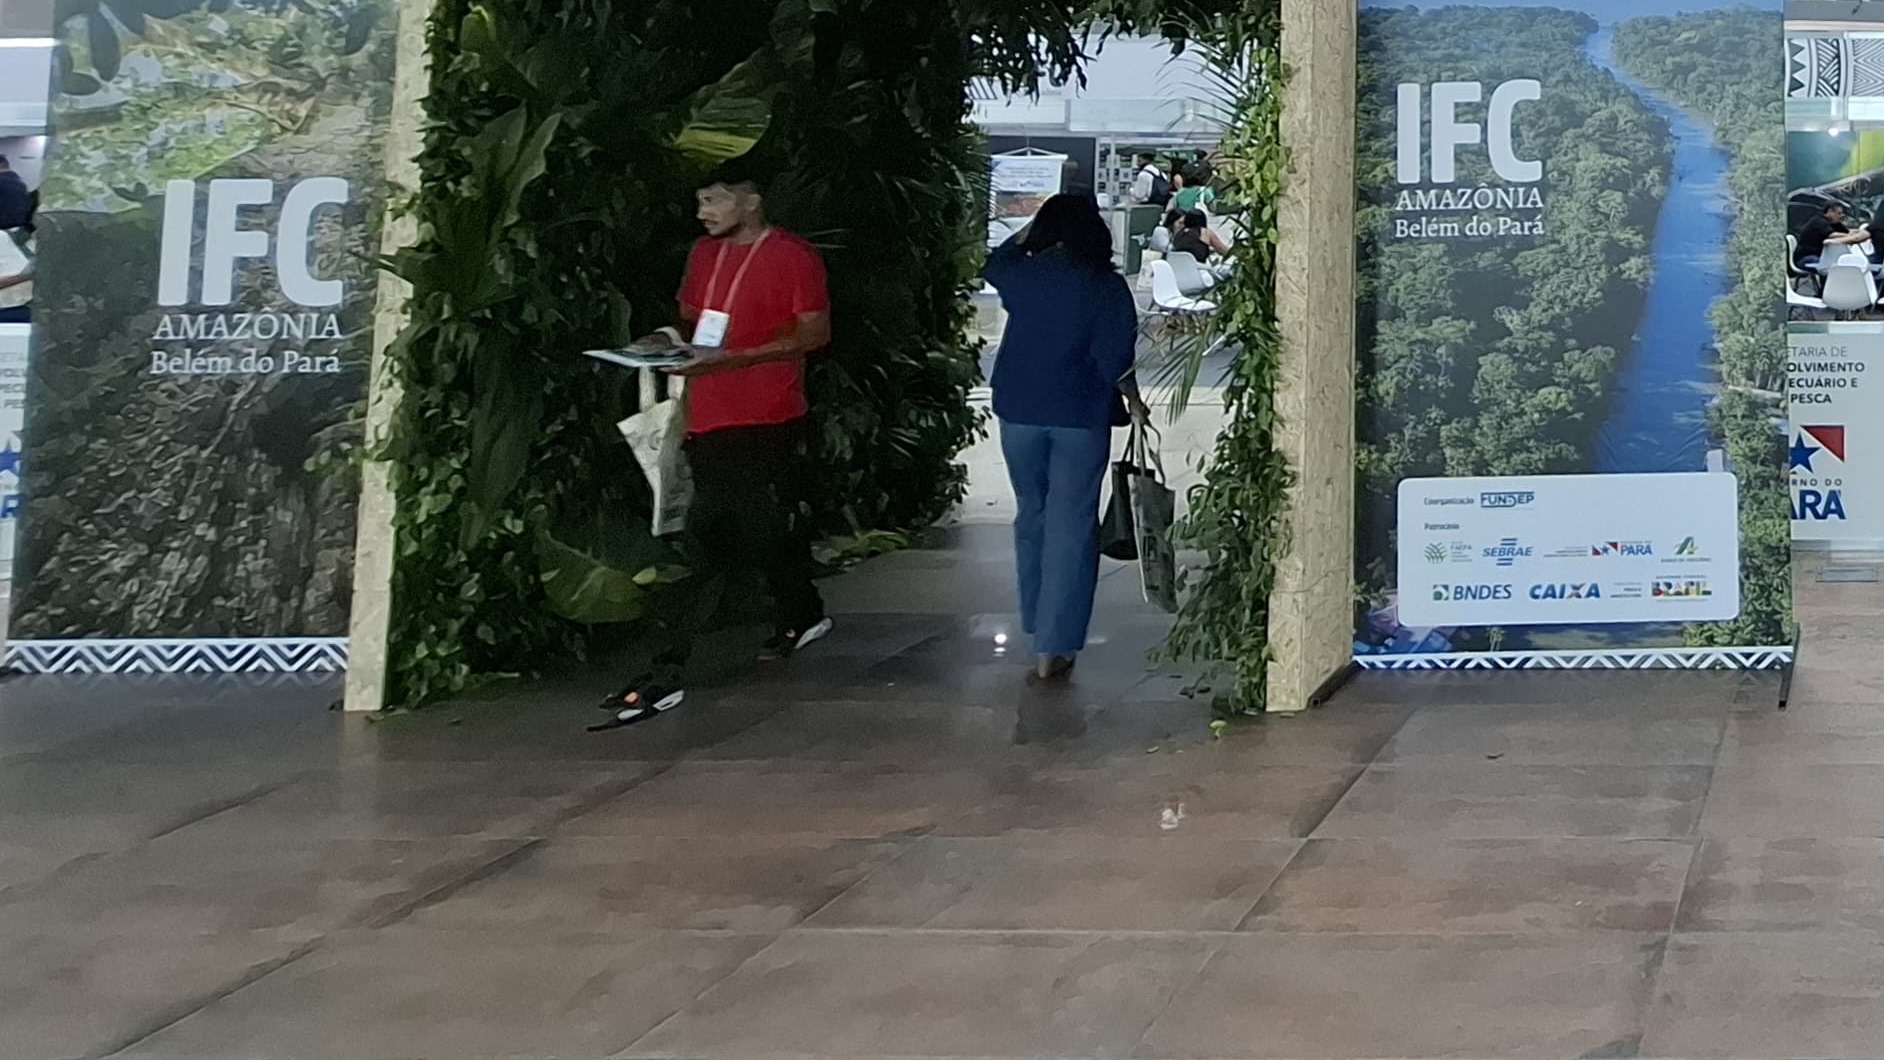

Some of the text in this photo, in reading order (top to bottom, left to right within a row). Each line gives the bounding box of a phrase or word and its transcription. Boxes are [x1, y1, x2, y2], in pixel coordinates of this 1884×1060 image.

[1397, 79, 1543, 184] IFC
[1395, 182, 1544, 210] AMAZÔNIA
[1395, 214, 1545, 238] Belém do Pará
[158, 177, 348, 306] IFC
[153, 308, 342, 340] AMAZÔNIA
[1831, 346, 1848, 357] DE
[150, 348, 340, 374] Belém do Pará
[1787, 362, 1865, 373] OLVIMENTO
[1788, 375, 1858, 389] ECUÁRIO E
[1790, 393, 1832, 404] PESCA
[1825, 478, 1842, 486] DO
[1481, 492, 1534, 508] FUNDEP
[1482, 546, 1533, 557] SEBRAE
[1453, 584, 1512, 601] BNDES
[1529, 582, 1600, 600] CAIXA
